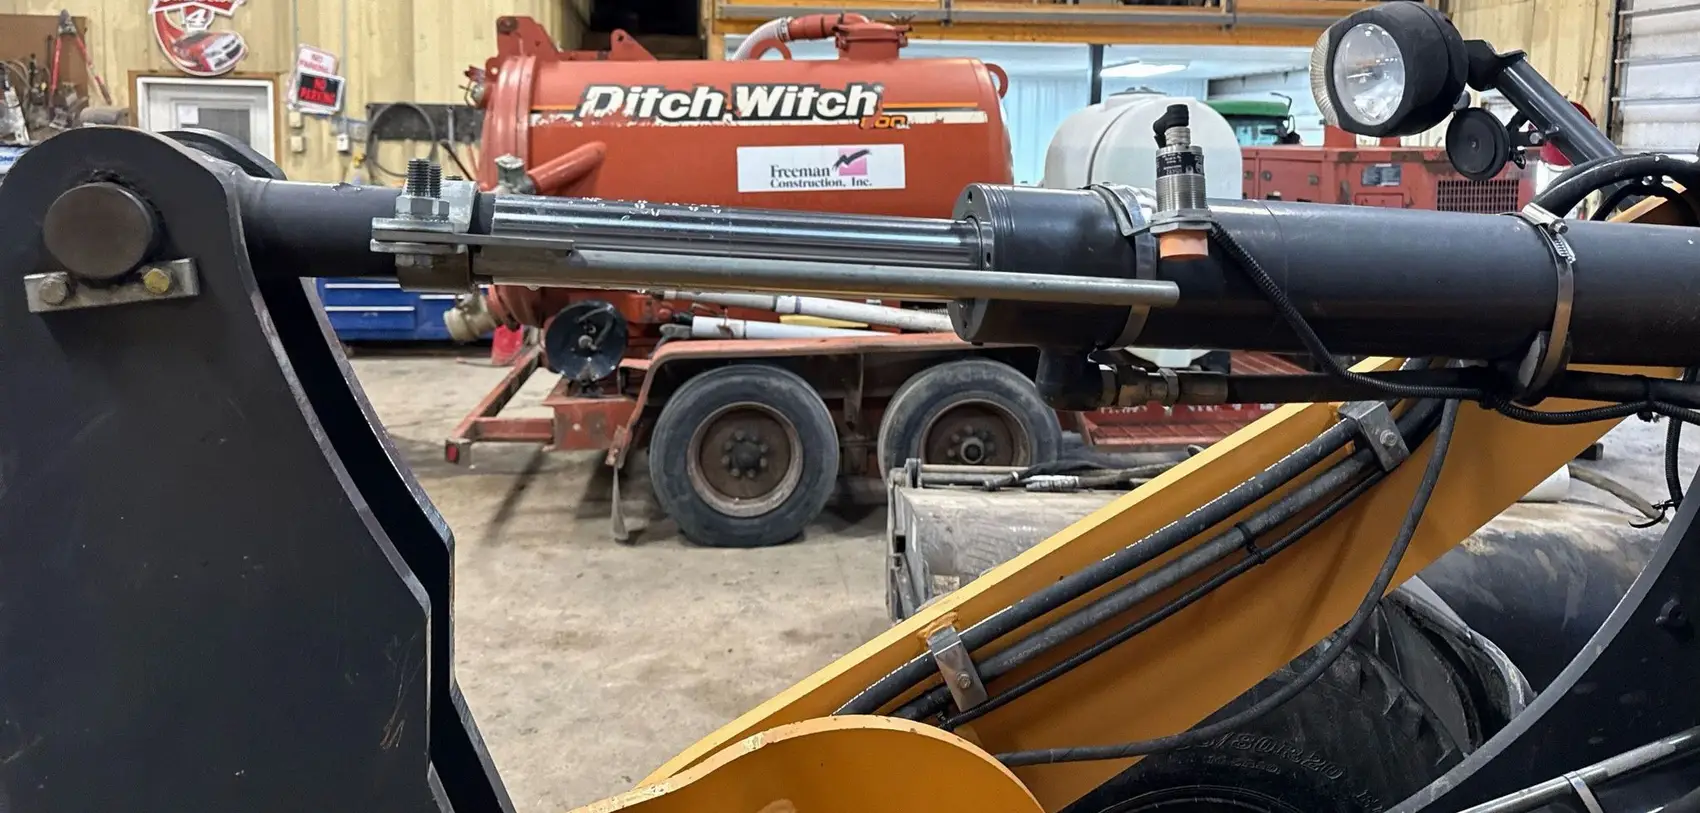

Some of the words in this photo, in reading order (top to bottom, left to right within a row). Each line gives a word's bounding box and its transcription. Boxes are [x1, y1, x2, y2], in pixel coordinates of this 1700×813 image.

[314, 77, 327, 91] NO
[299, 88, 336, 105] PARKING
[579, 86, 724, 118] Ditch
[736, 85, 877, 117] Witch
[770, 165, 830, 178] Freeman
[770, 177, 846, 188] Construction,
[852, 177, 873, 187] Inc.
